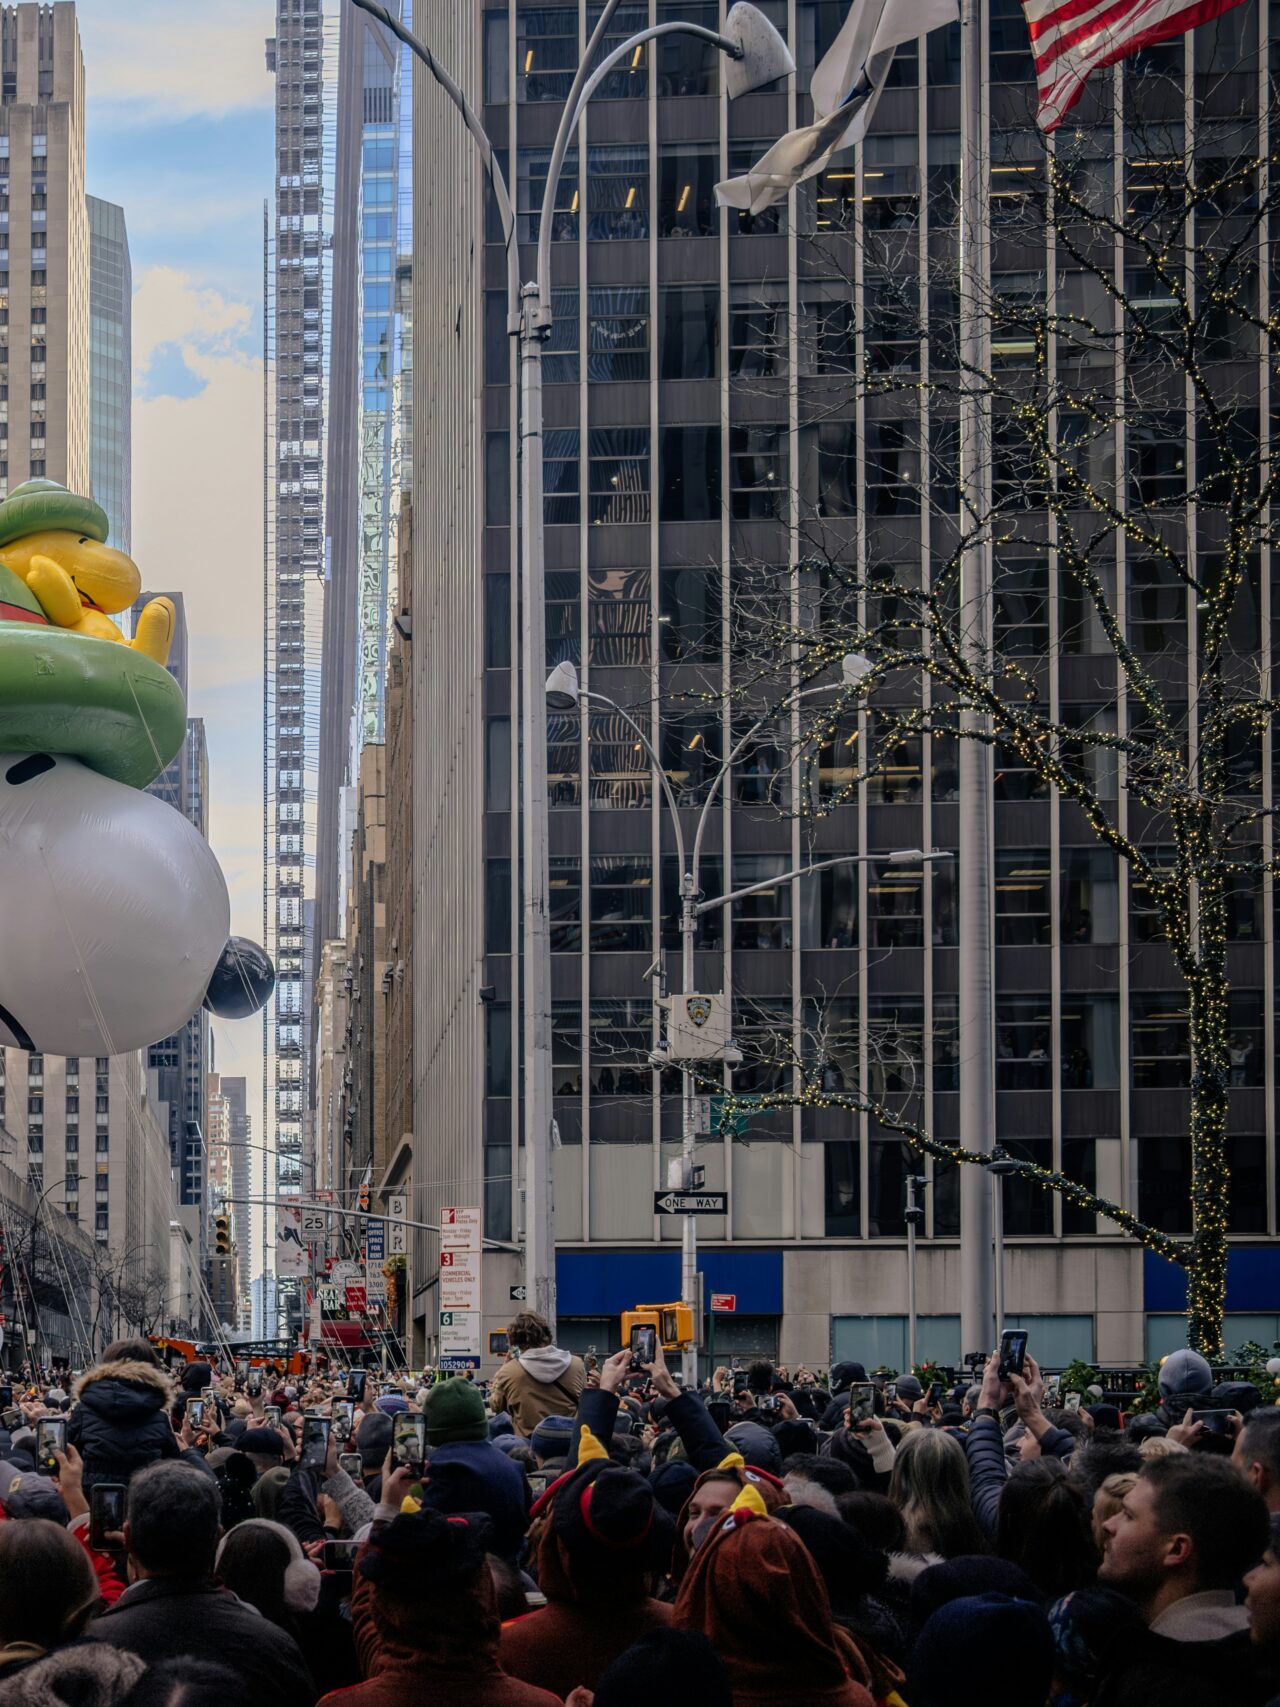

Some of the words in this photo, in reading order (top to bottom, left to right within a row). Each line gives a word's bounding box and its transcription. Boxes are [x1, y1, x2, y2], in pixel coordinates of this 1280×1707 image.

[665, 1199, 686, 1208] ONE
[696, 1199, 718, 1208] WAY
[305, 1217, 323, 1229] 25
[392, 1200, 403, 1250] BAR
[443, 1254, 451, 1266] 3
[323, 1300, 341, 1310] BAR
[443, 1313, 450, 1326] 6
[440, 1361, 465, 1369] 105290
